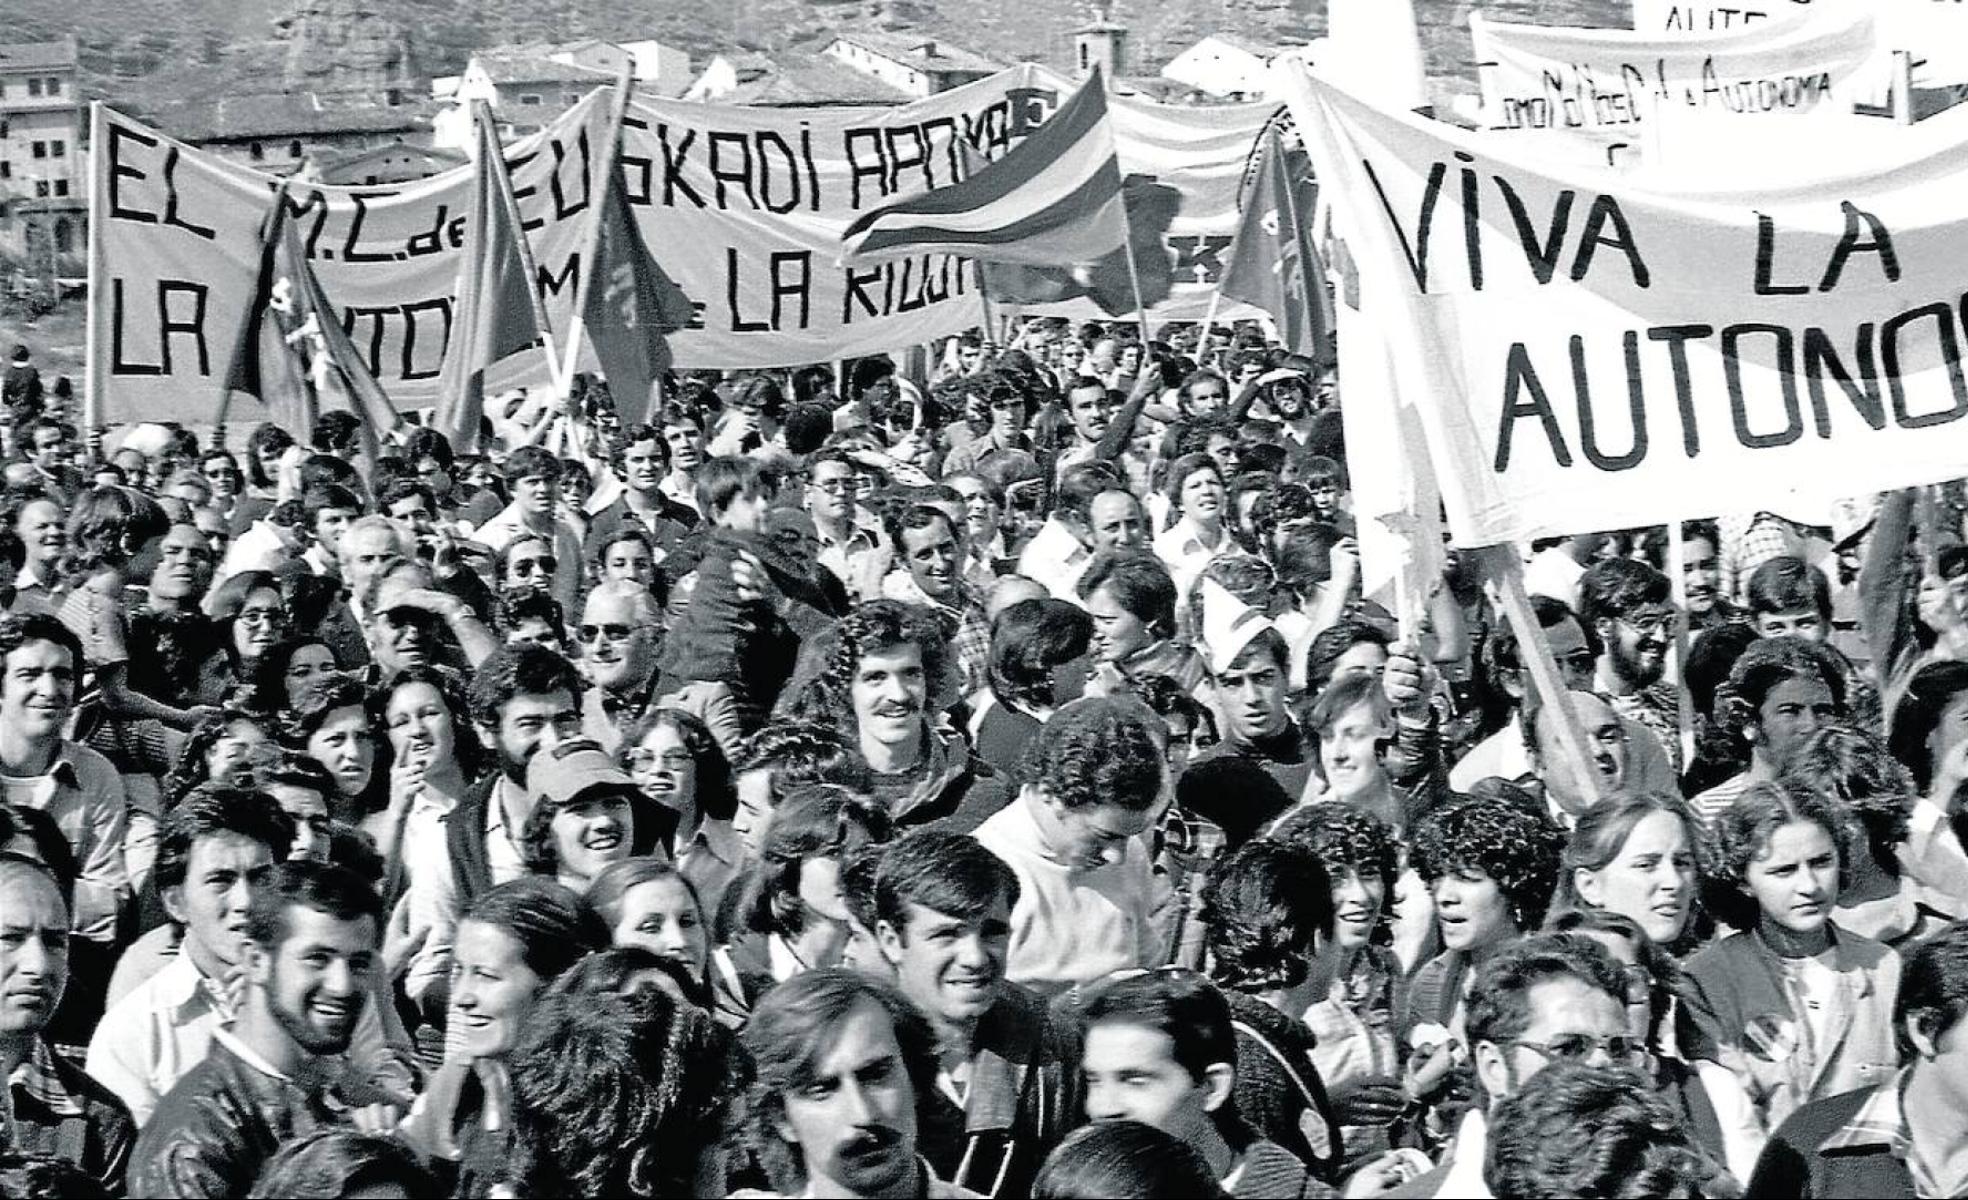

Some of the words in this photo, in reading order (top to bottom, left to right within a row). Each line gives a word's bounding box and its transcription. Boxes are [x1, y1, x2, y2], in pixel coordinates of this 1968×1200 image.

[109, 122, 216, 240] EL
[1362, 149, 1650, 294] VIVA
[1752, 200, 1901, 295] LA
[112, 277, 211, 377] LA
[727, 246, 812, 332] LA
[1494, 290, 1968, 473] AUTONO
